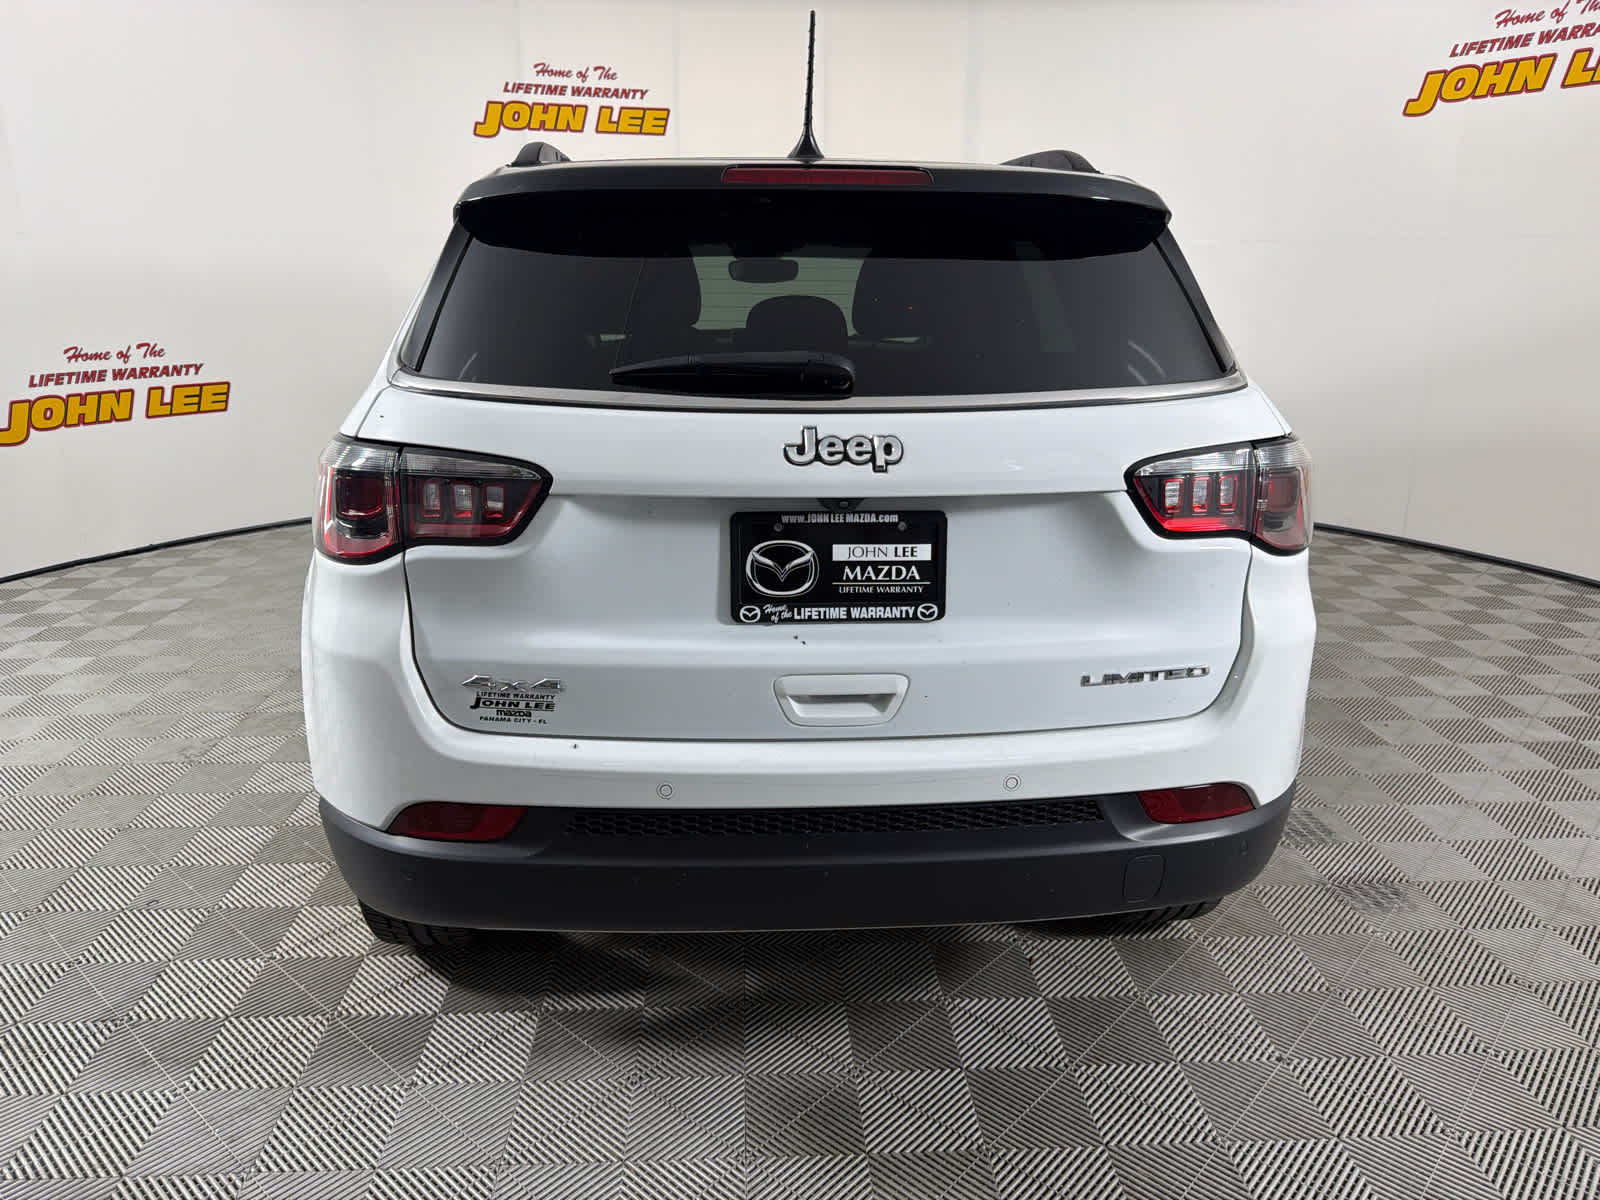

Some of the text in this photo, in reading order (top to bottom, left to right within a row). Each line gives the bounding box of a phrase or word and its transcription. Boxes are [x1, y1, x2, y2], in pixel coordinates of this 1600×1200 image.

[1495, 9, 1545, 28] Home
[1550, 0, 1568, 24] of
[1449, 32, 1535, 58] LIFETIME
[533, 62, 618, 83] Home of The
[1402, 47, 1600, 117] JOHN L
[503, 82, 648, 100] LIFETIME WARRANTY
[473, 100, 670, 138] JOHN LEE
[63, 342, 165, 364] Home of The
[28, 363, 204, 388] LIFETIME WARRANTY
[0, 381, 230, 447] JOHN LEE
[783, 426, 904, 473] Jeep
[847, 546, 918, 559] JOHN LEE
[842, 565, 920, 581] MAZDA
[839, 585, 924, 594] LIFETIME WARRANTY
[794, 606, 915, 620] LIFETIME WARRANTY
[462, 675, 563, 692] 4x4
[1080, 665, 1210, 688] LIMITED
[470, 697, 556, 710] JOHN LEE
